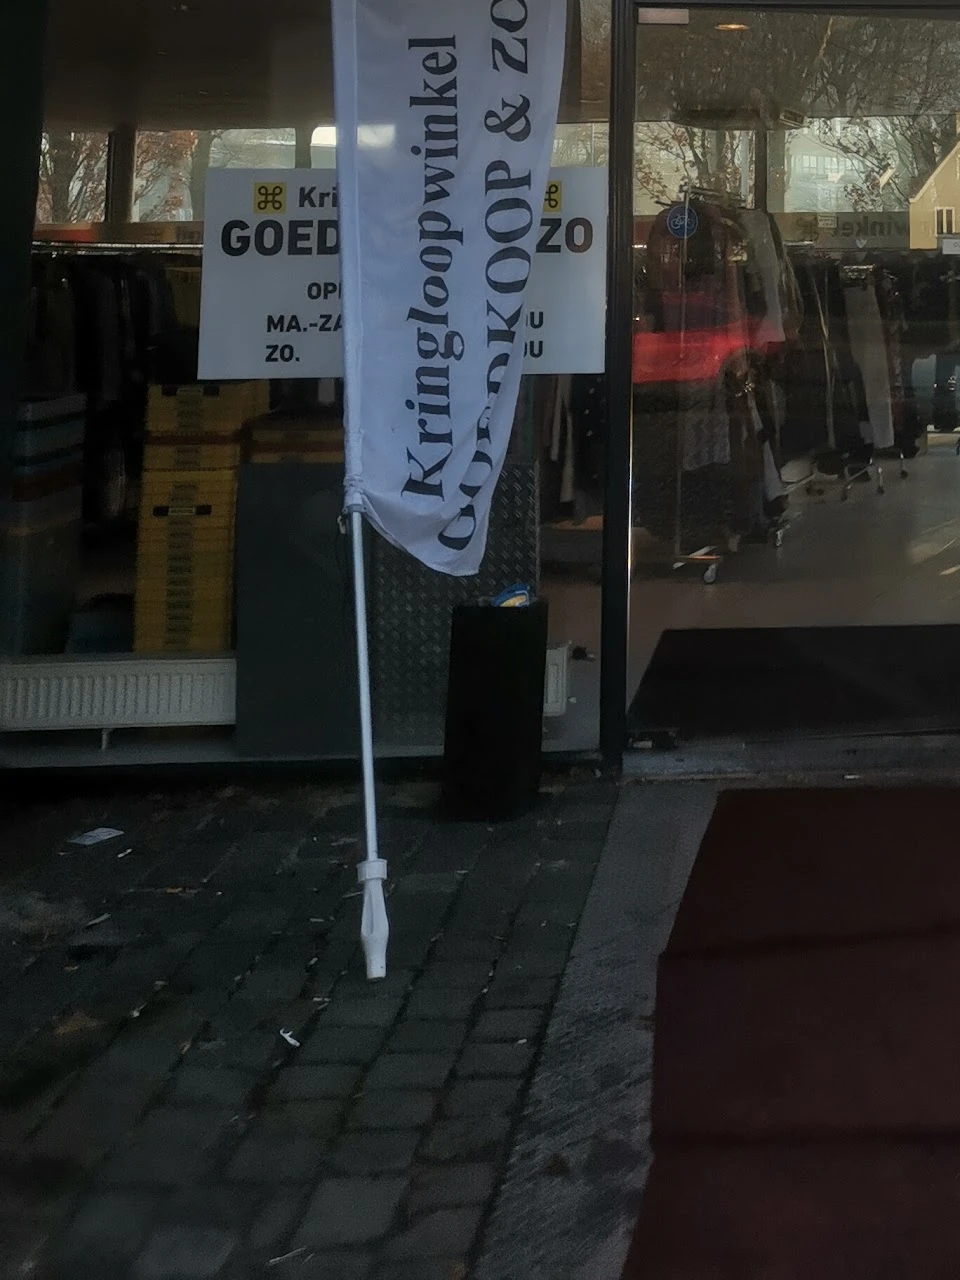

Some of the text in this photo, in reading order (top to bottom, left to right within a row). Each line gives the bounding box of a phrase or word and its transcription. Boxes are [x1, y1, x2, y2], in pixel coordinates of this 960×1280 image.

[484, 92, 532, 140] &
[221, 217, 594, 256] GOED ZO
[401, 34, 465, 501] Kringloopwinkel
[265, 345, 299, 362] ZO.
